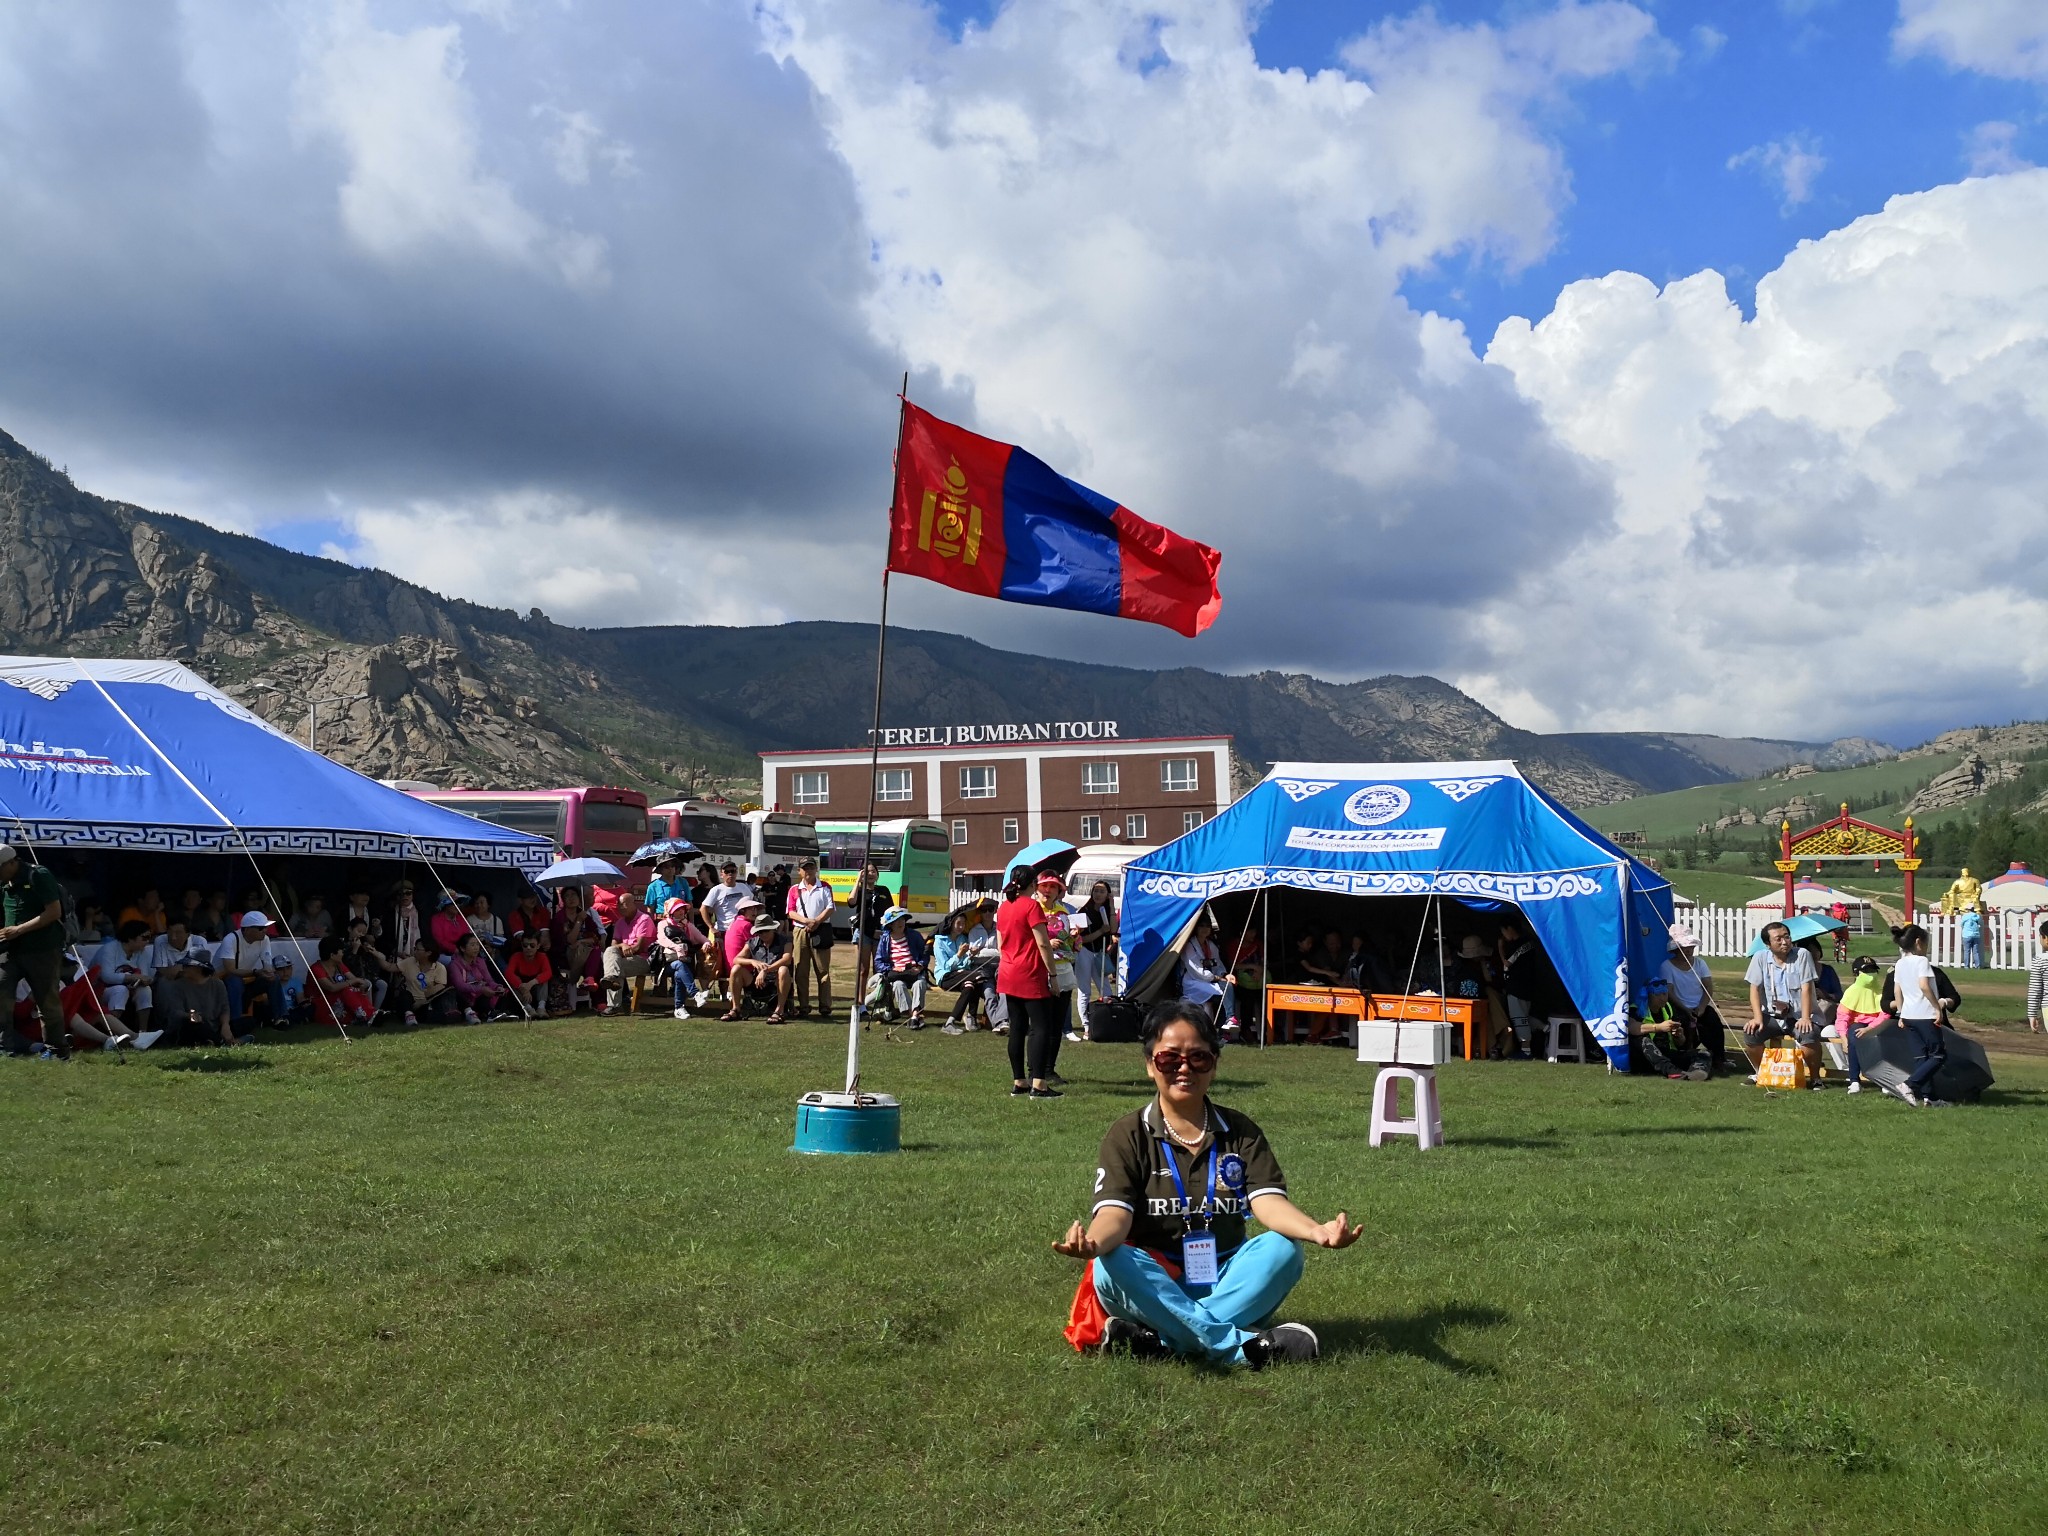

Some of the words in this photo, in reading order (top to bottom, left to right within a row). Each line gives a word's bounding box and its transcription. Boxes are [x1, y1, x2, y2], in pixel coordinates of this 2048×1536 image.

[956, 723, 1051, 743] BUMBAN
[1055, 720, 1119, 739] TOUR
[18, 759, 46, 771] OF
[46, 761, 153, 777] MONGOLIA
[1291, 839, 1324, 847] TOURISM
[1325, 841, 1378, 849] CORPORATION
